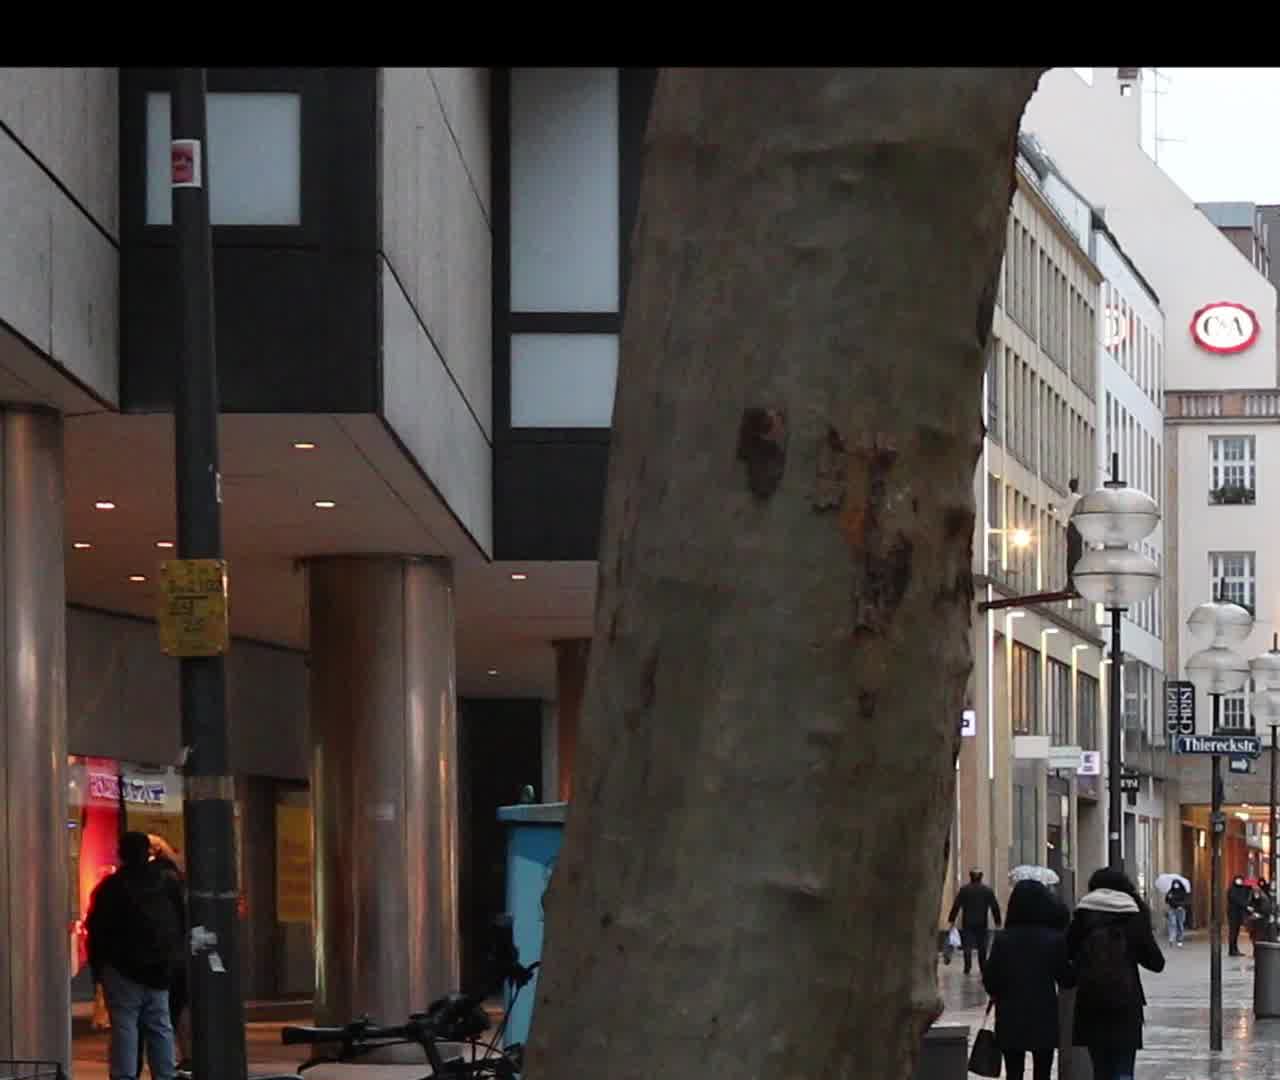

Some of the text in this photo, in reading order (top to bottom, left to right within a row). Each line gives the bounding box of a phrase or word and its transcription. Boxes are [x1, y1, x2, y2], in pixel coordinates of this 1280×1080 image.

[1203, 315, 1244, 337] C&A
[1180, 688, 1193, 734] CHRIST
[1183, 738, 1256, 752] Thiereckstr.
